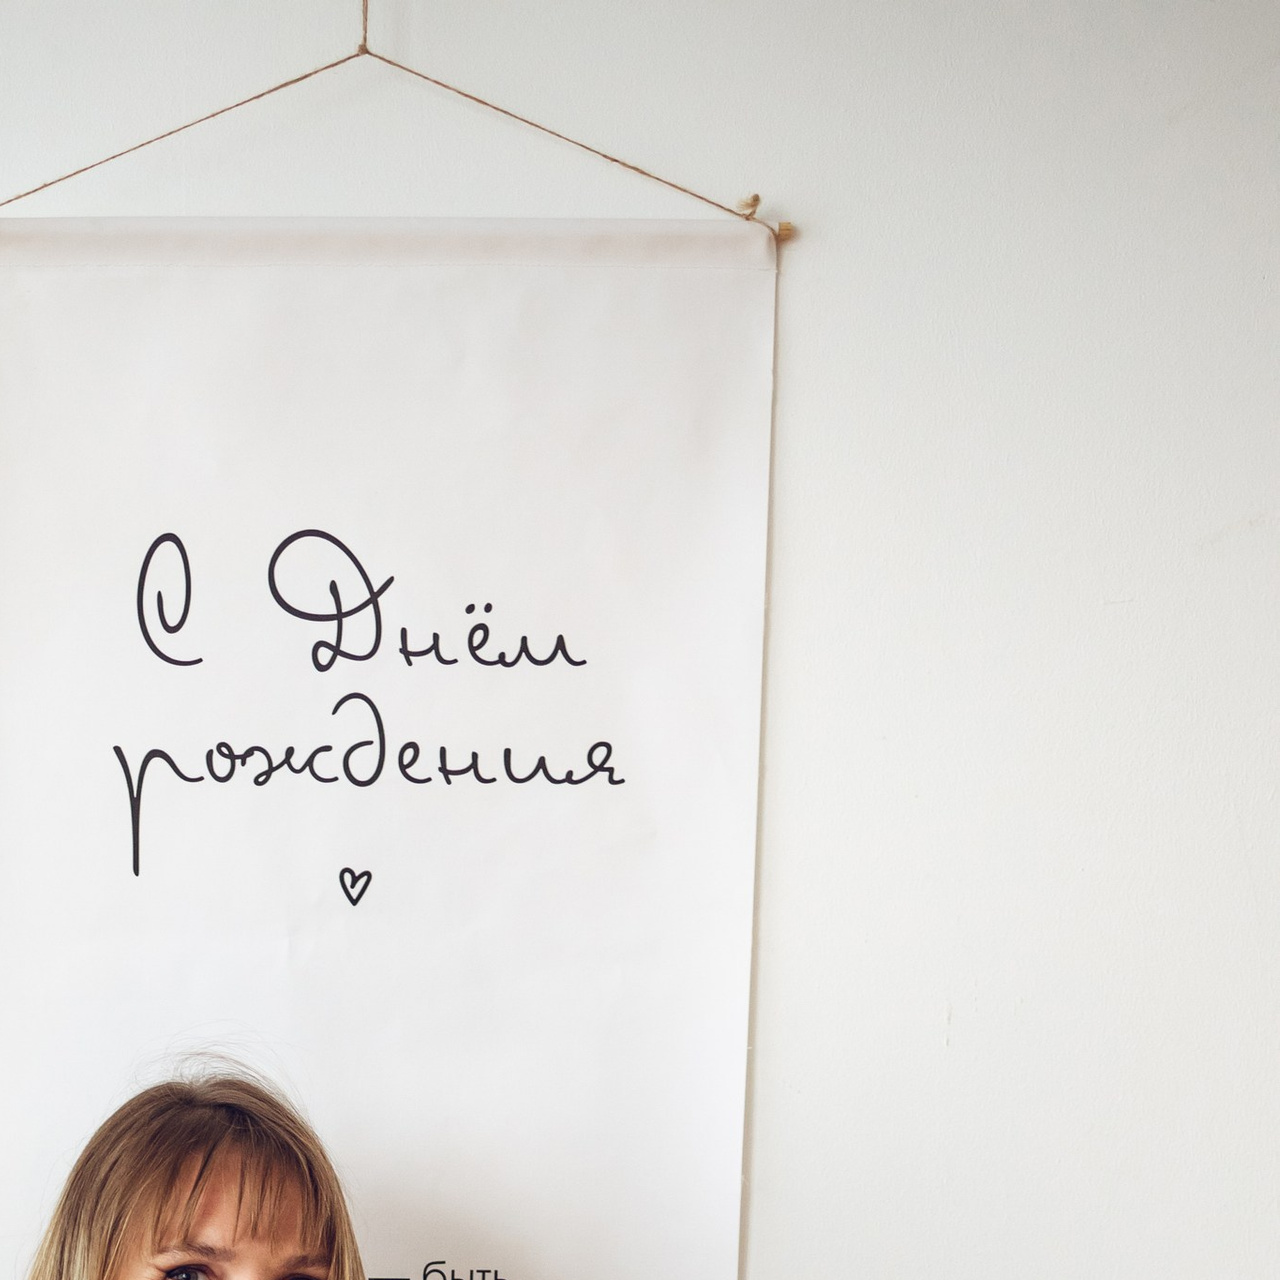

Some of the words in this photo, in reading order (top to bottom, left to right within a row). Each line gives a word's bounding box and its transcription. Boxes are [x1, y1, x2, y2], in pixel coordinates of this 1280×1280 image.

[136, 532, 204, 667] С
[267, 529, 588, 673] Днём
[112, 692, 626, 877] рождения
